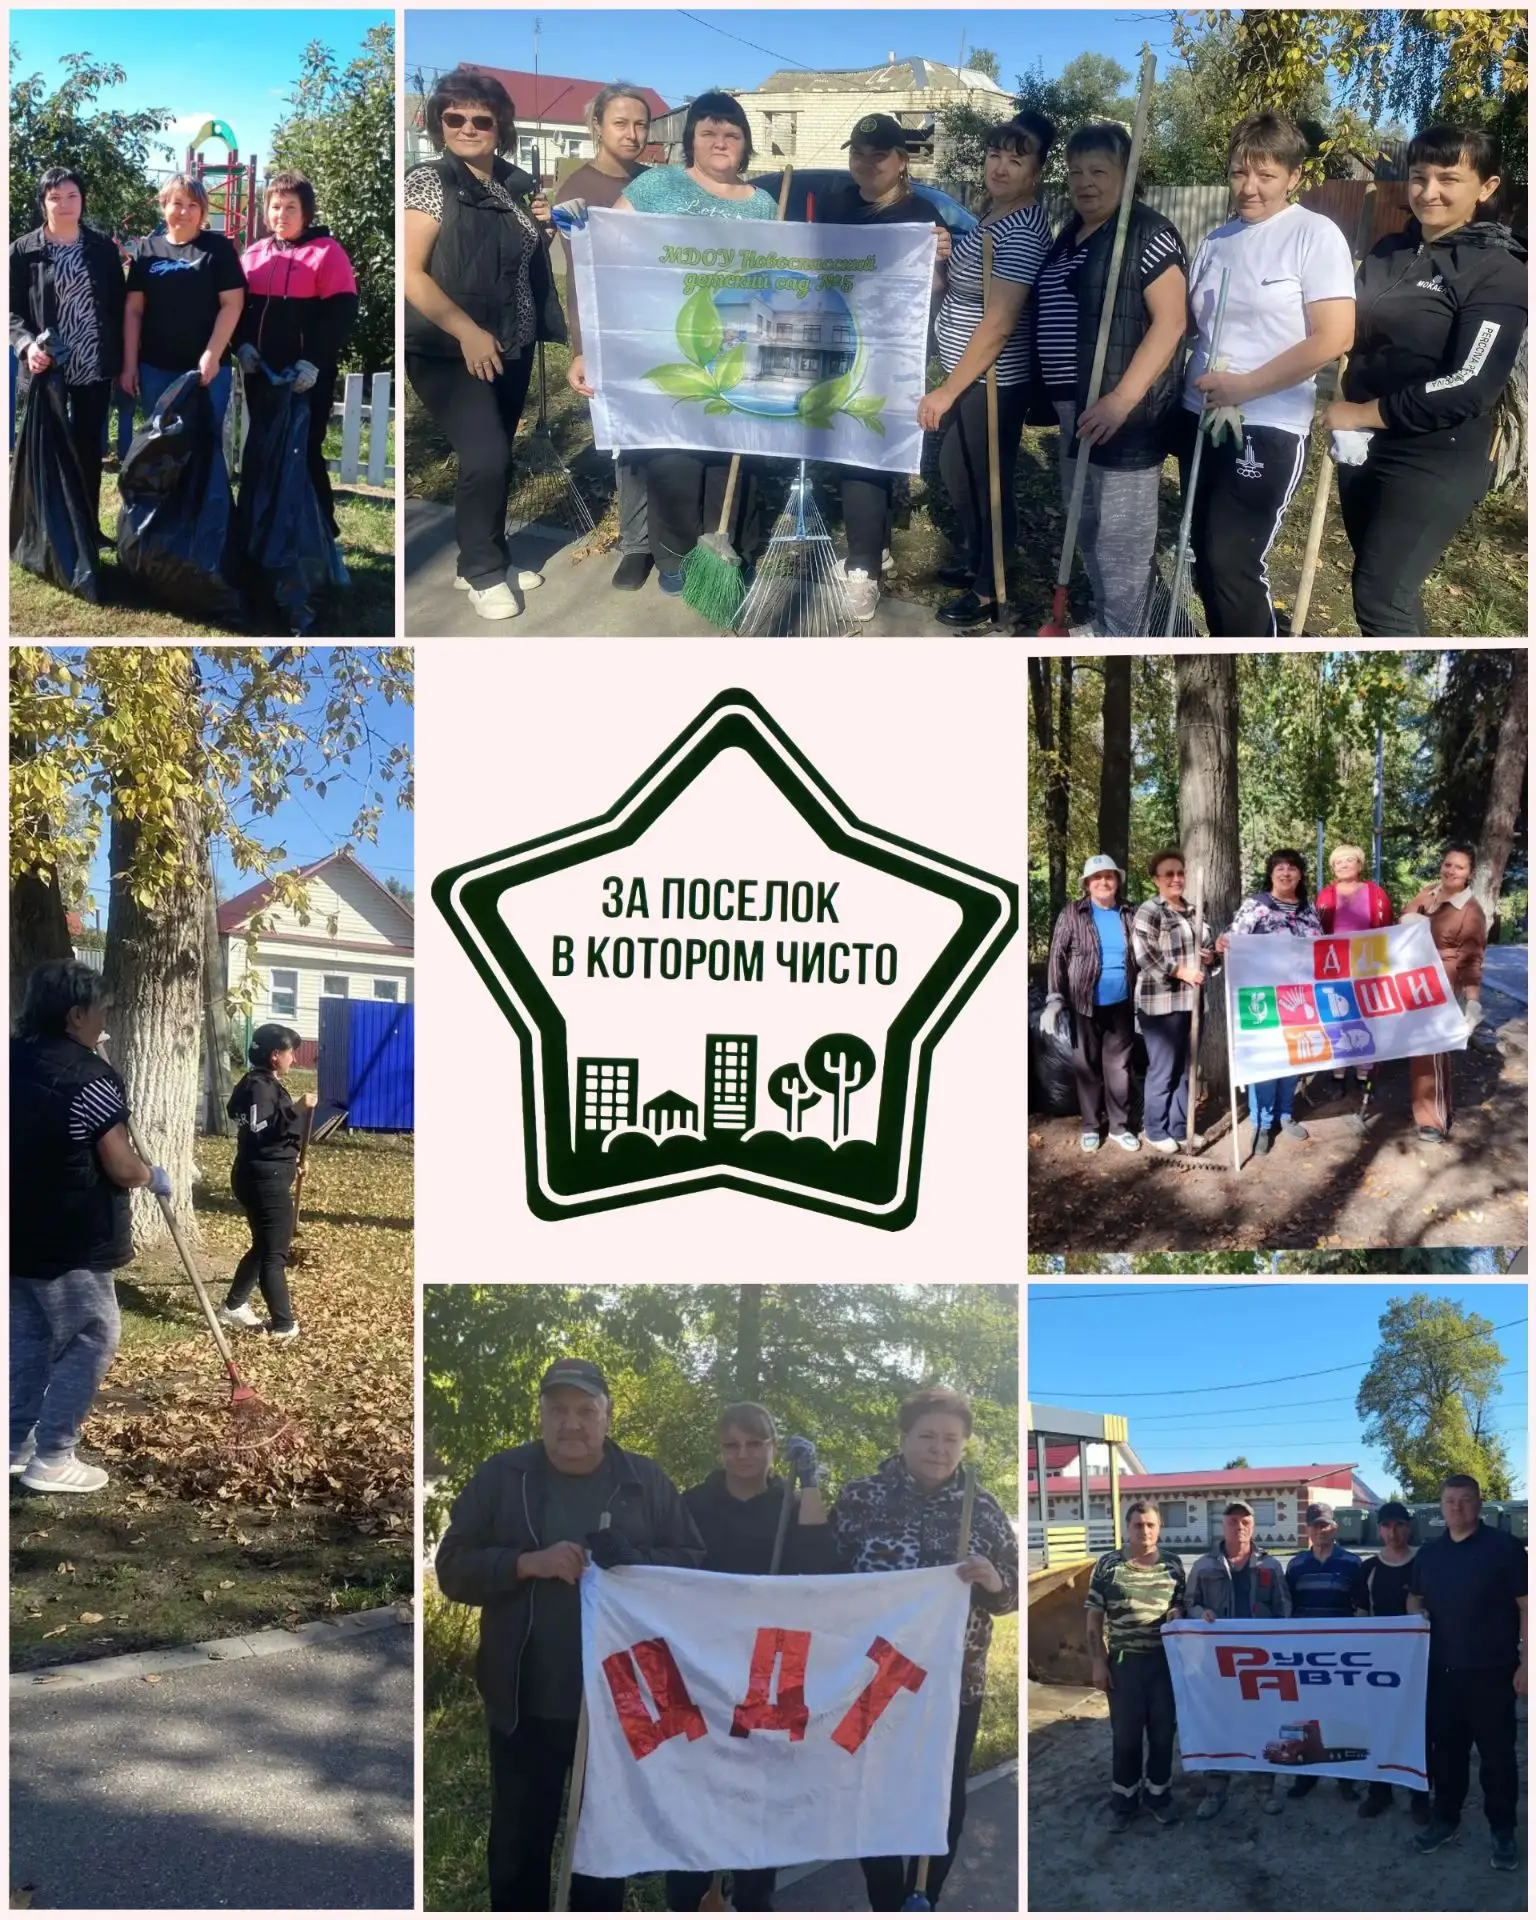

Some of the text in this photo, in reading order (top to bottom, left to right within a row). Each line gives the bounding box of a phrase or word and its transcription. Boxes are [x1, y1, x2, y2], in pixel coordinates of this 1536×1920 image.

[659, 245, 736, 268] МДОУ
[683, 270, 770, 295] детский
[775, 277, 811, 299] сад
